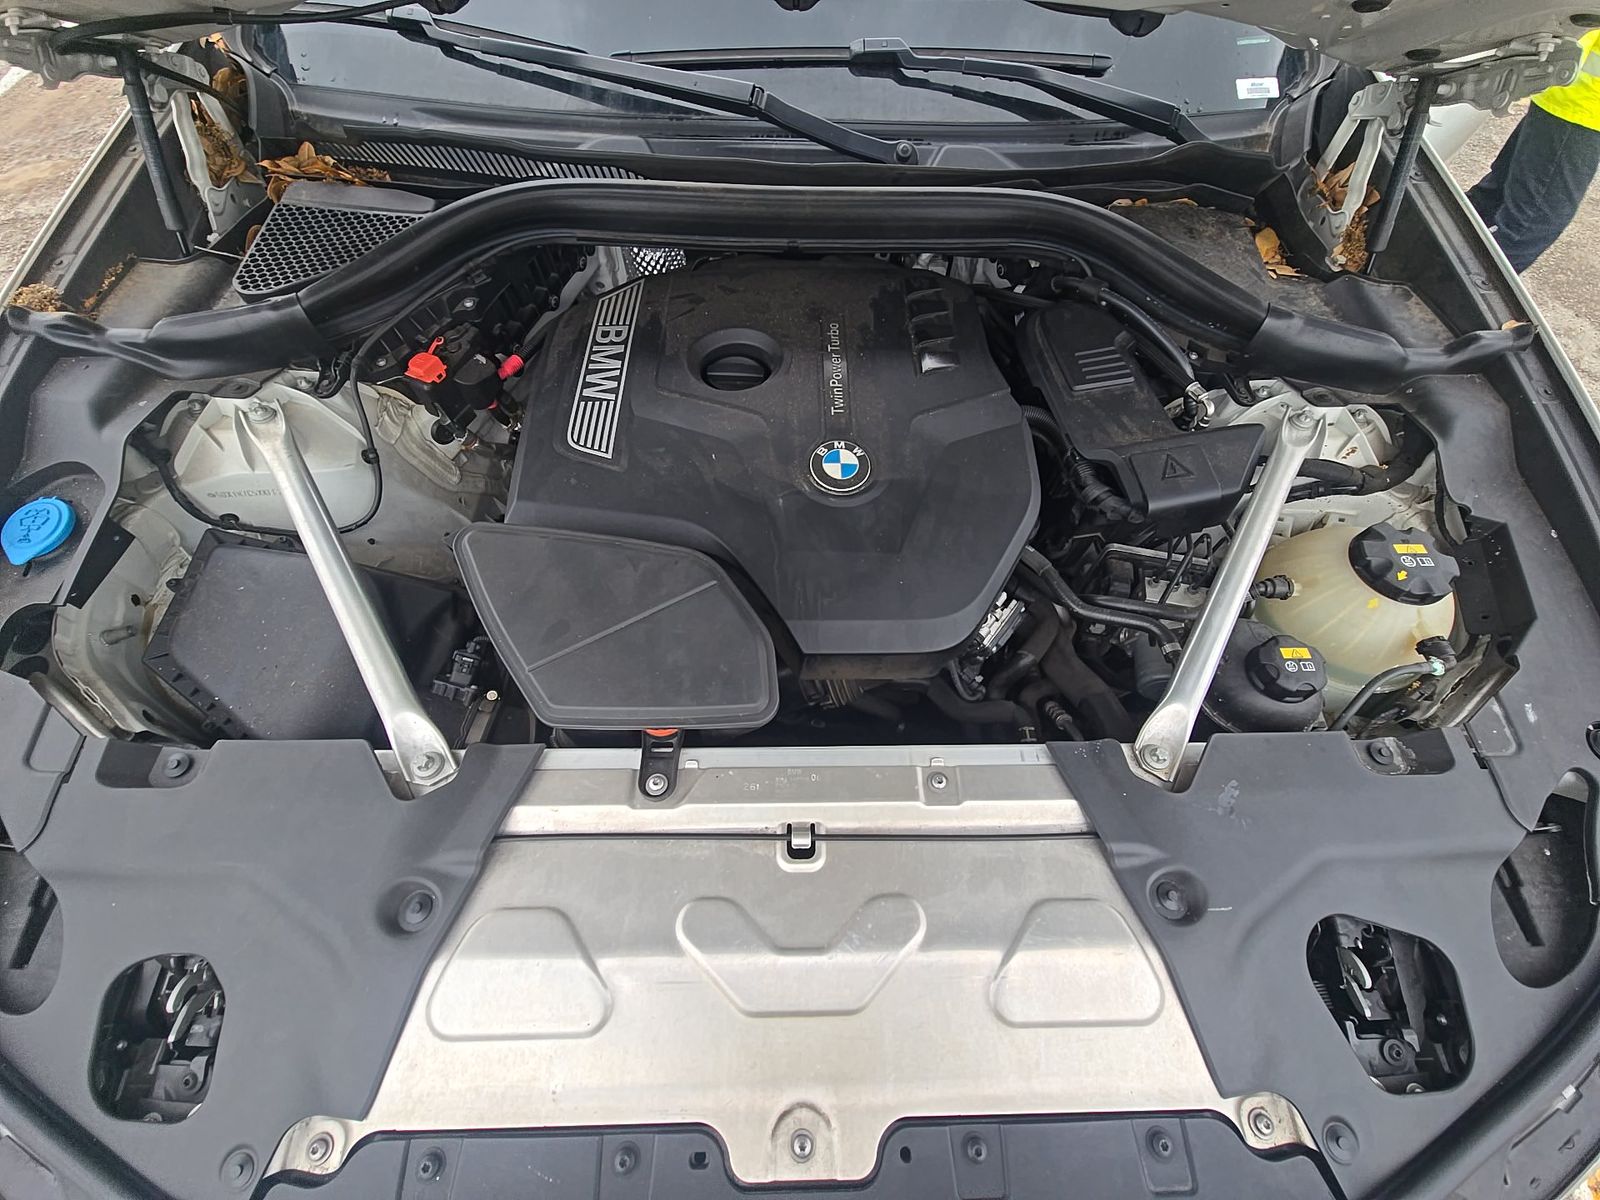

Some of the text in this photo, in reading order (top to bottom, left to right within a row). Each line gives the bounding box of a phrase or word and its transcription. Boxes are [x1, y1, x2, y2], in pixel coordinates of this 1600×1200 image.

[582, 325, 629, 401] BMW
[827, 322, 845, 415] TwinPower Turbo
[816, 440, 865, 457] BMW
